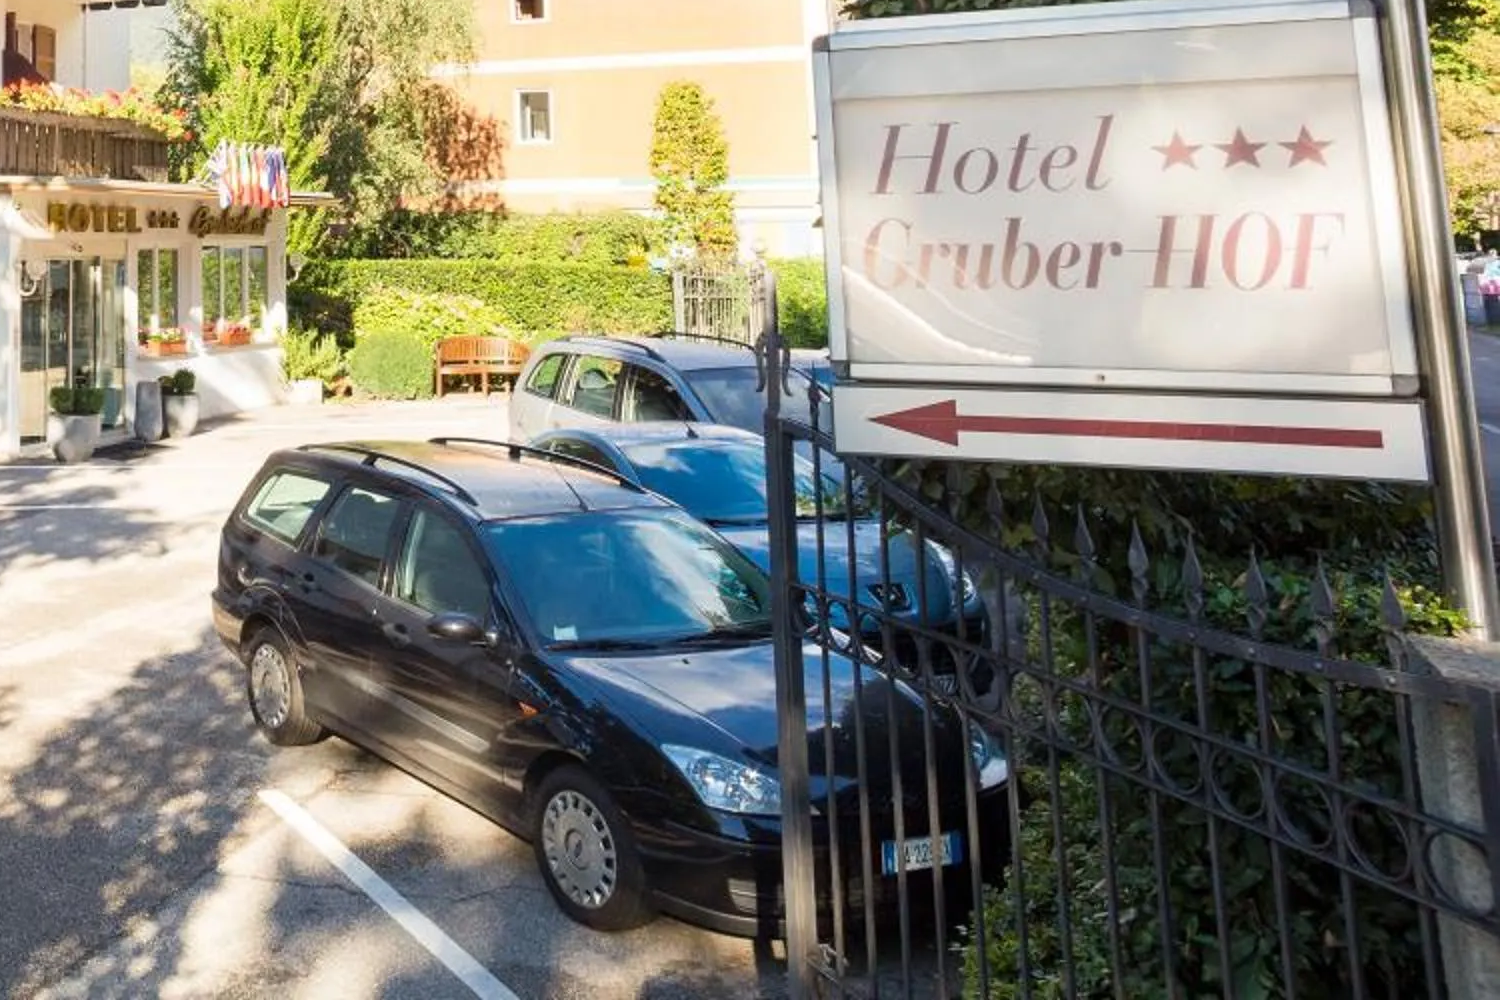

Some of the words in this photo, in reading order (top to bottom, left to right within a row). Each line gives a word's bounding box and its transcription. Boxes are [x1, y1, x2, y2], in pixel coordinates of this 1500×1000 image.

[868, 113, 1114, 196] Hotel
[47, 202, 142, 233] HOTEL
[863, 215, 1122, 292] Gruber
[1147, 211, 1345, 292] HOF
